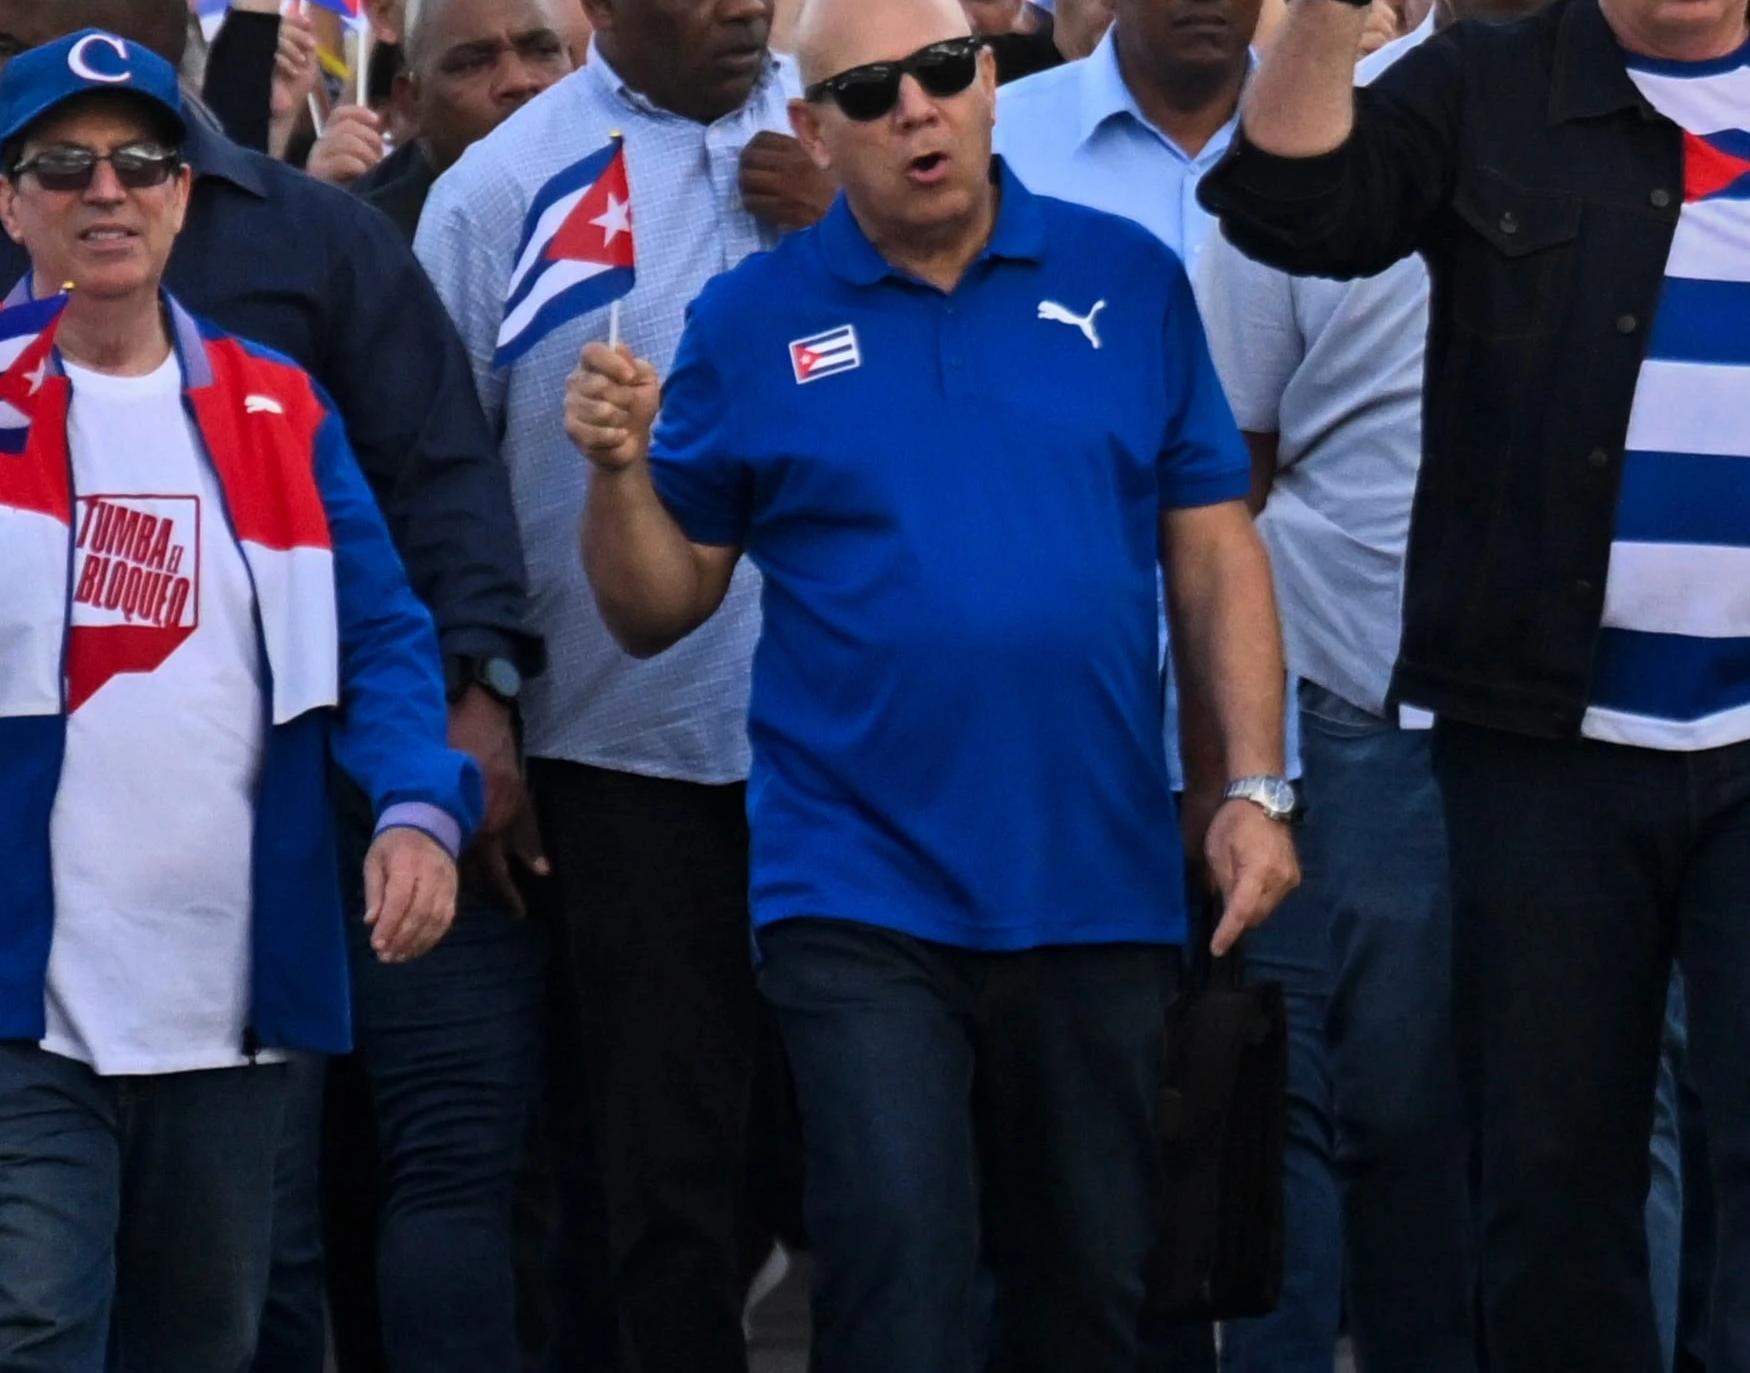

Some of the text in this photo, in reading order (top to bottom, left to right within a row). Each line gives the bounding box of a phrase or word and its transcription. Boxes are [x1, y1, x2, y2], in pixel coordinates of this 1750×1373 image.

[67, 33, 132, 84] C
[76, 496, 174, 570] TUMBA
[73, 553, 190, 628] BLOQUEO
